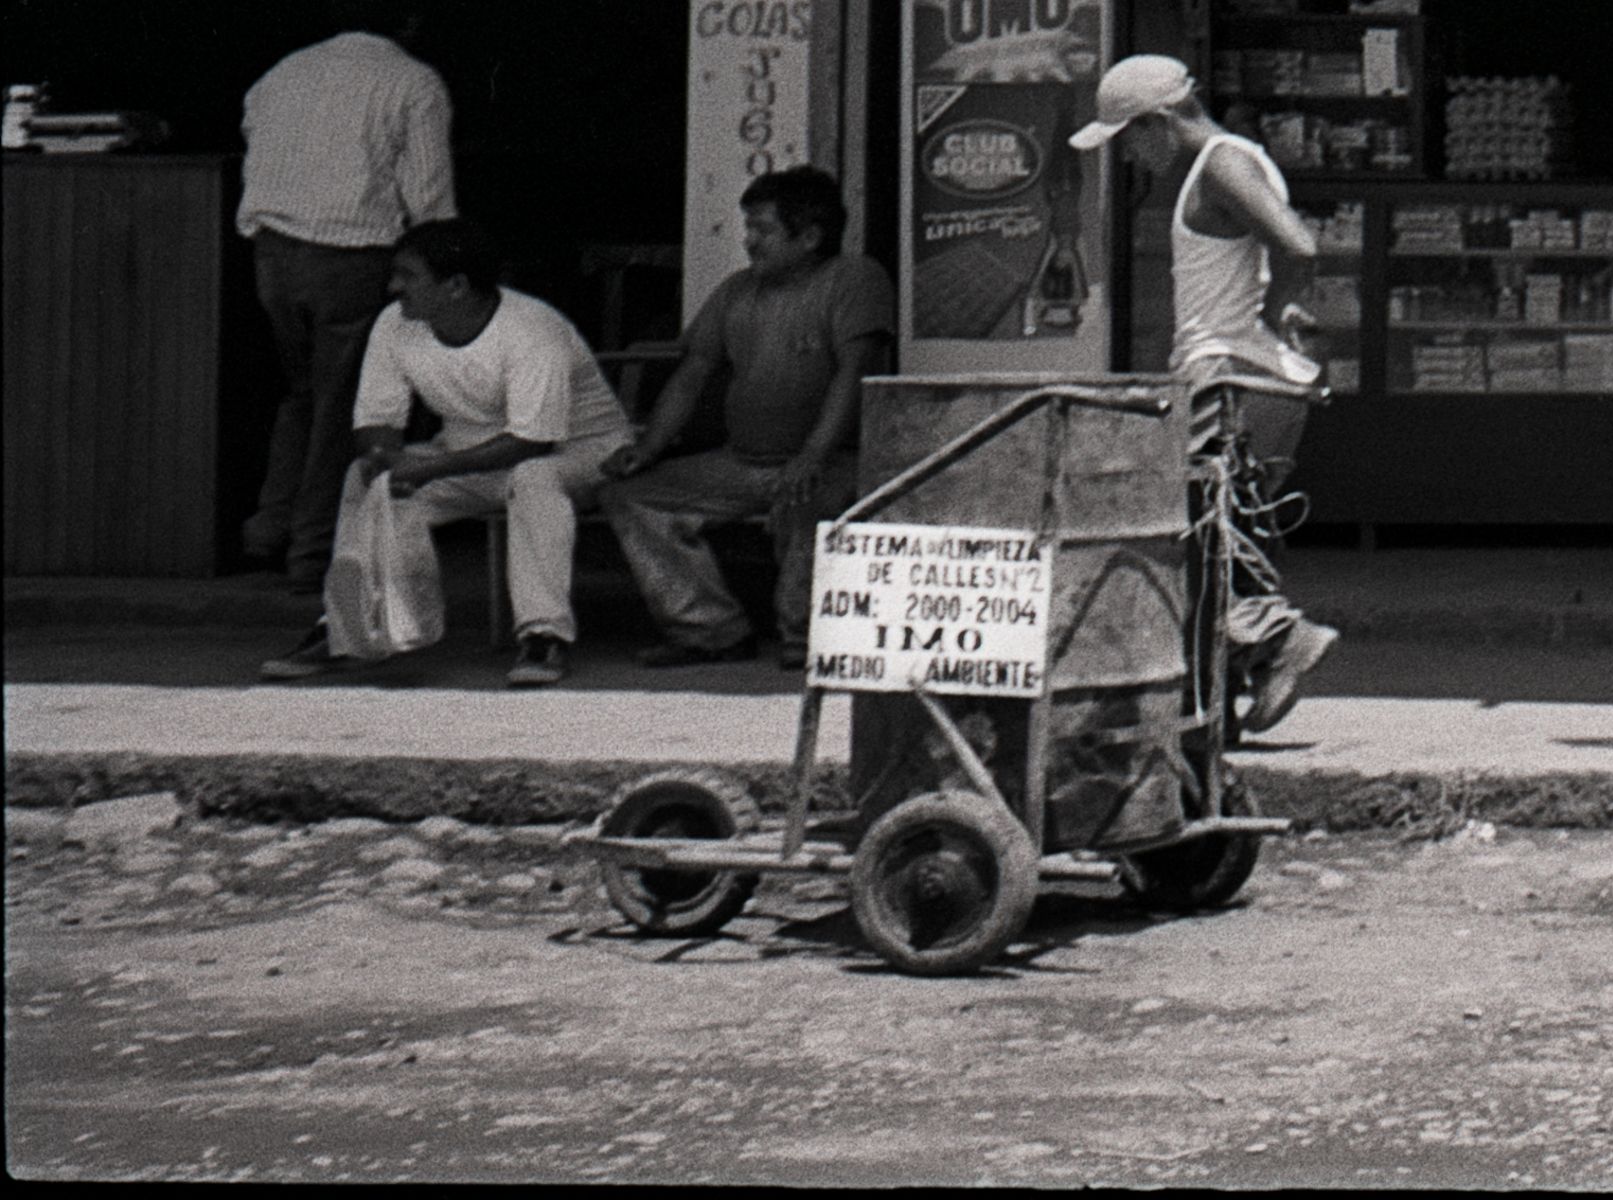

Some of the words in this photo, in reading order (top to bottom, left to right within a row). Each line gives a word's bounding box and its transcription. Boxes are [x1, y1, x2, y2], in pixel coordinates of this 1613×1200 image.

[696, 0, 811, 43] COLAS
[943, 132, 1018, 155] CLUB
[932, 155, 1030, 177] SOCIAL
[824, 530, 923, 557] SISTEMA
[867, 561, 894, 585] DE
[909, 563, 996, 590] CALLES
[819, 589, 880, 619] ADM:
[905, 592, 1037, 626] 2000-2004
[815, 653, 885, 680] MEDIO
[923, 656, 1036, 690] AMBIENTE
